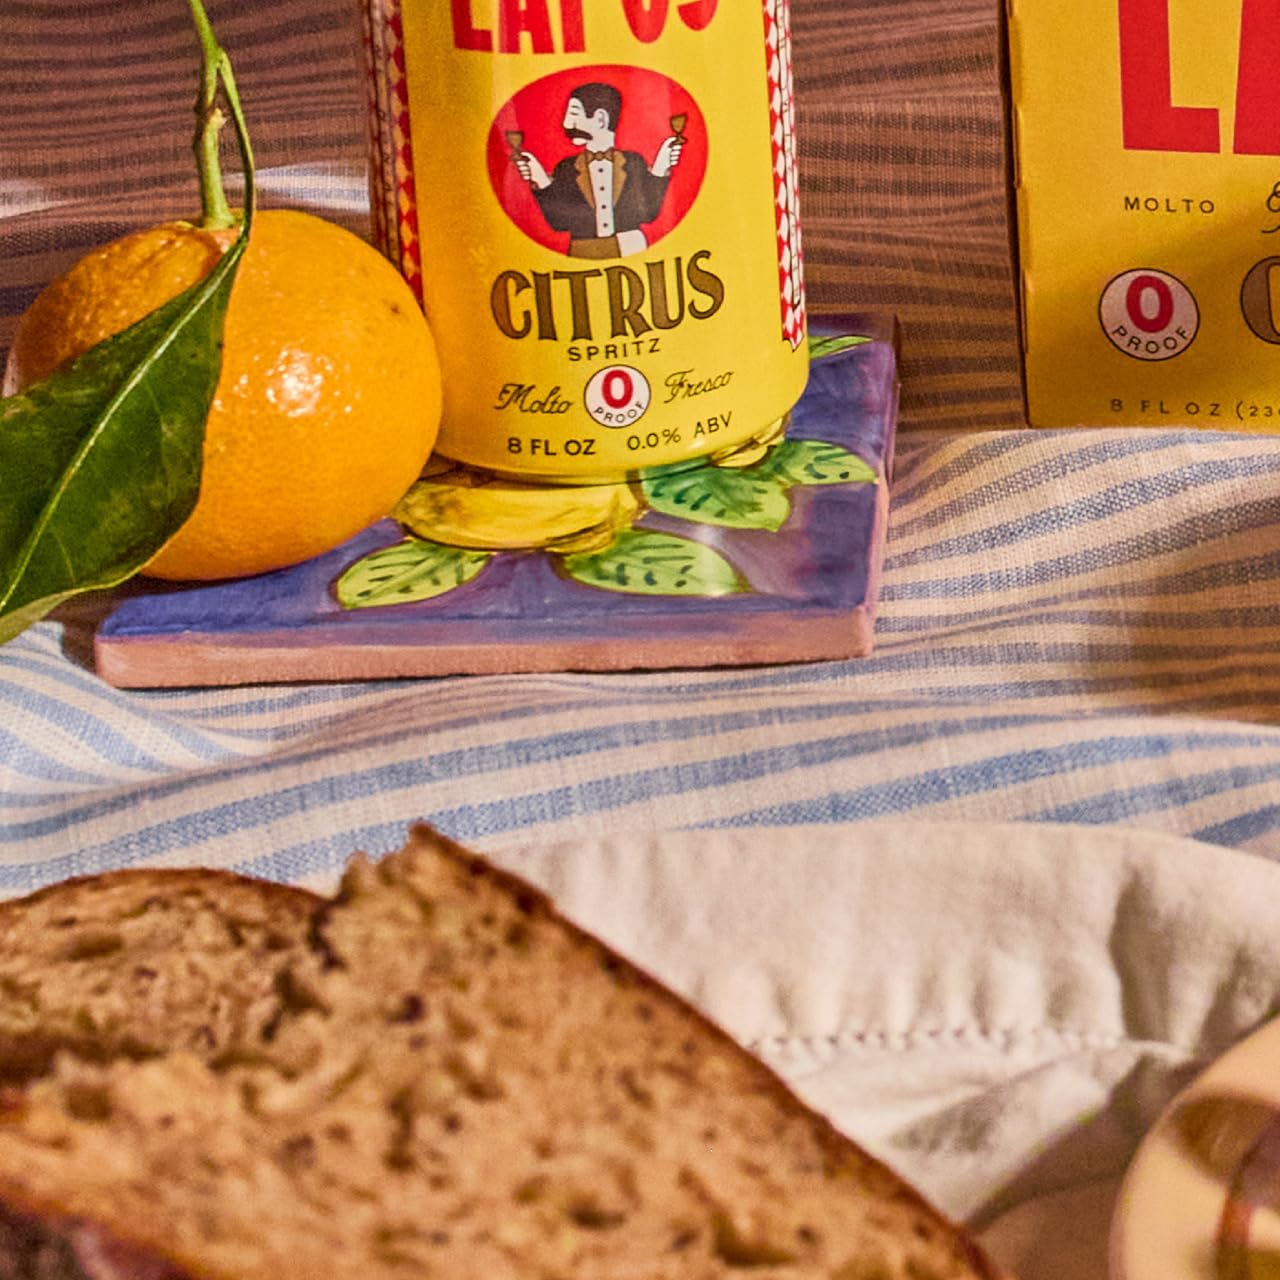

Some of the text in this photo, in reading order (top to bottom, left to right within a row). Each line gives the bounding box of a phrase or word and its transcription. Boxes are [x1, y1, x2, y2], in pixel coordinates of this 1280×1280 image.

[1123, 196, 1216, 214] MOLTO
[490, 250, 725, 341] CITRUS
[1126, 275, 1174, 333] 0
[568, 338, 660, 361] SPRITZ
[1112, 325, 1189, 354] PROOF
[494, 383, 573, 414] Molto
[602, 370, 633, 409] 0
[664, 368, 734, 403] Fresco
[594, 401, 644, 424] PROOF
[1110, 399, 1123, 412] 8
[1141, 400, 1169, 414] FL
[1185, 403, 1220, 416] OZ
[507, 412, 733, 455] 8 FL OZ 0.0% ABV
